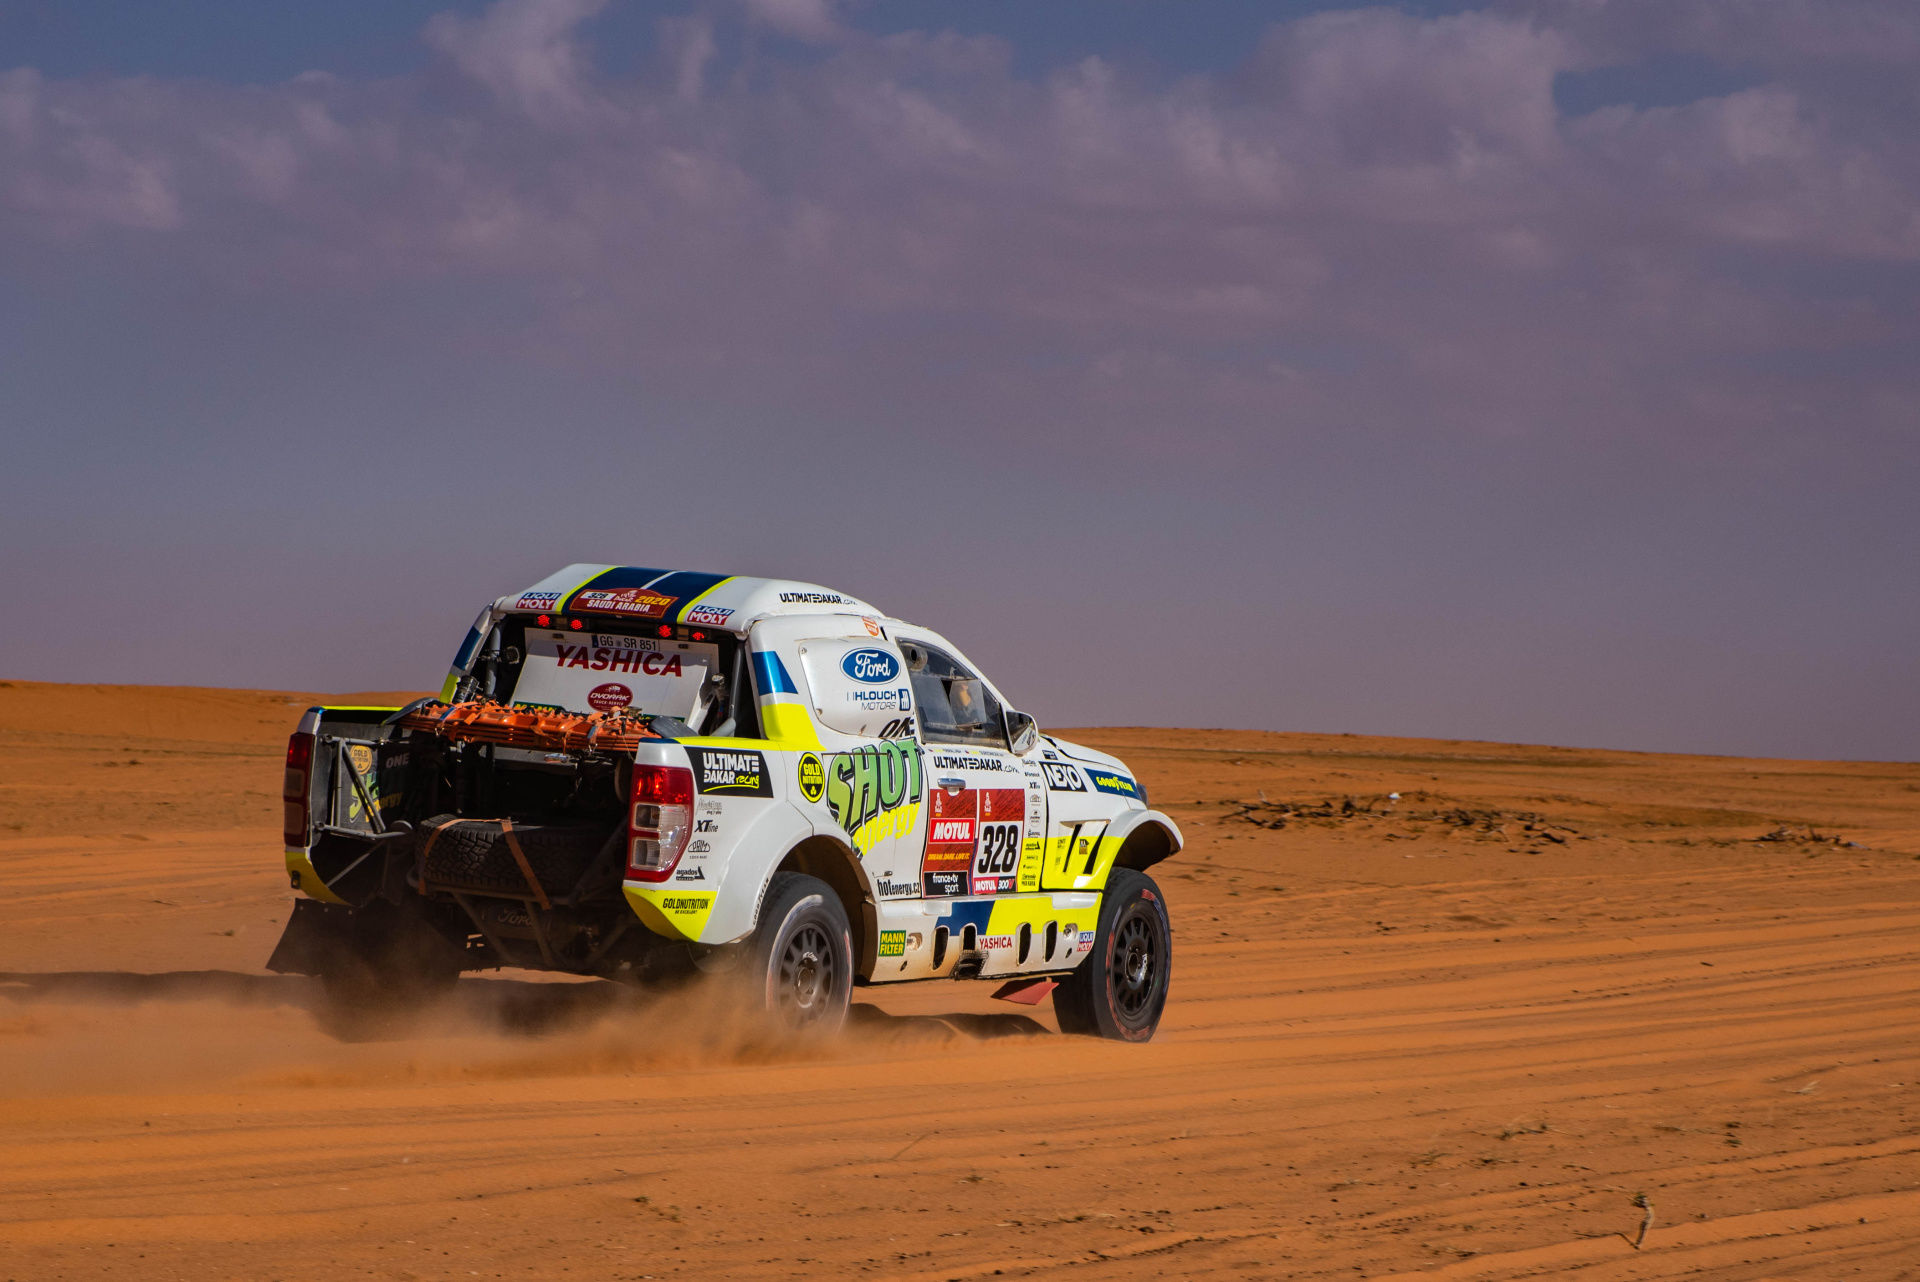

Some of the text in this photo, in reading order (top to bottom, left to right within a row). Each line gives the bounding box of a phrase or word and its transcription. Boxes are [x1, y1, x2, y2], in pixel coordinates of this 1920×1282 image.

[517, 599, 554, 608] MOLY
[587, 599, 650, 612] SAUDI ARABIA
[635, 596, 670, 605] 2020
[695, 606, 732, 615] LIQUI
[689, 612, 727, 624] MOLY
[600, 636, 656, 651] GG SR 851
[556, 645, 682, 677] YASHICA
[855, 653, 891, 678] Ford
[855, 691, 896, 700] HLOUCH
[862, 702, 896, 711] MOTORS
[386, 752, 409, 768] ONE
[703, 753, 759, 772] ULTIMATE
[804, 764, 820, 775] GOLD
[704, 770, 760, 788] DAKAR racing
[1043, 765, 1083, 791] NEXO
[828, 738, 923, 832] SHOT
[853, 802, 920, 857] energy
[933, 822, 970, 840] MOTUL
[978, 825, 1018, 873] 328
[677, 869, 697, 877] agados
[877, 879, 920, 896] hotenergy.cz
[945, 884, 959, 895] sport
[975, 879, 996, 891] MOTUL
[663, 898, 709, 910] GOLDNUTRITION
[882, 934, 905, 943] MANN
[979, 937, 1012, 950] YASHICA
[880, 944, 904, 953] FILTER
